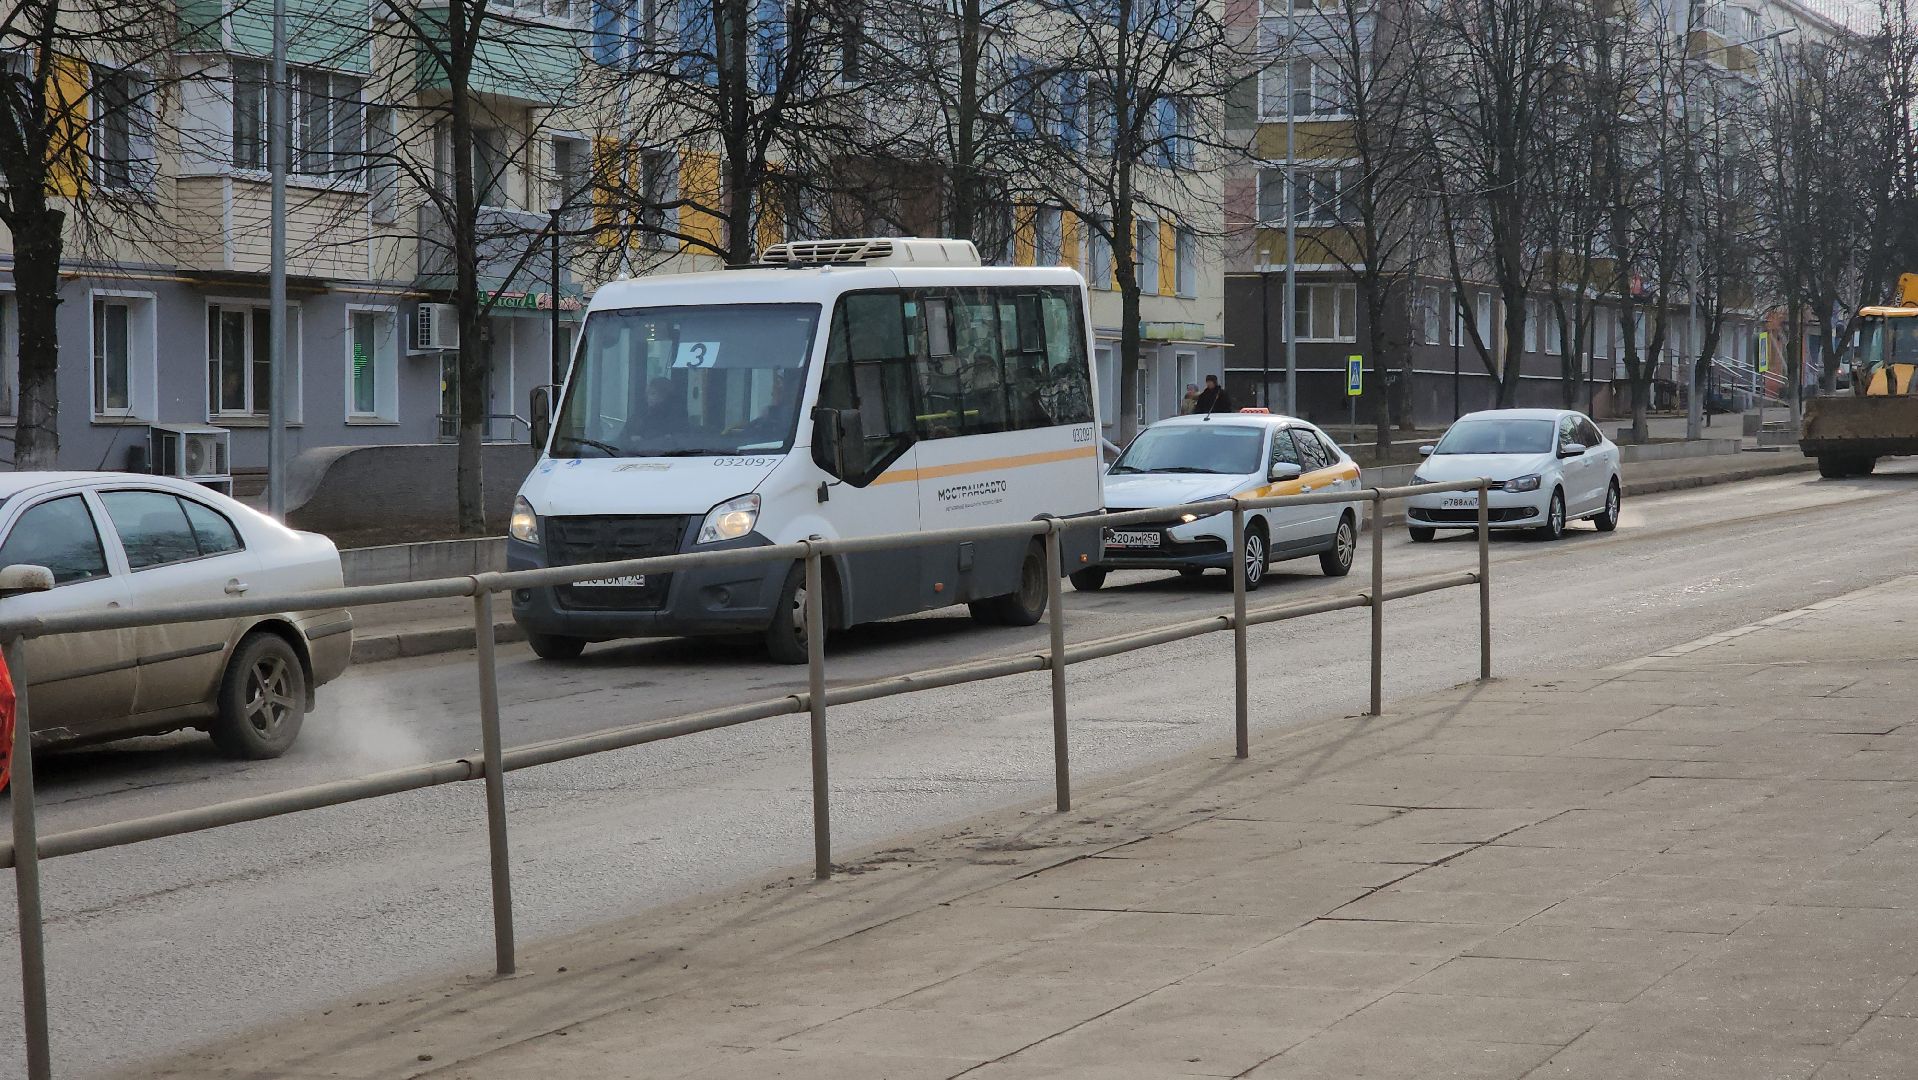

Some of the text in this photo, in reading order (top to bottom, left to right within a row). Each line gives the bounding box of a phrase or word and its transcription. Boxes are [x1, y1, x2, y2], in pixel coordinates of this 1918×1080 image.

[686, 342, 707, 368] 3
[1072, 427, 1093, 442] 032097
[713, 458, 777, 467] 032097
[937, 480, 1007, 501] МОСТРАНСАВТО
[1143, 533, 1158, 542] 250
